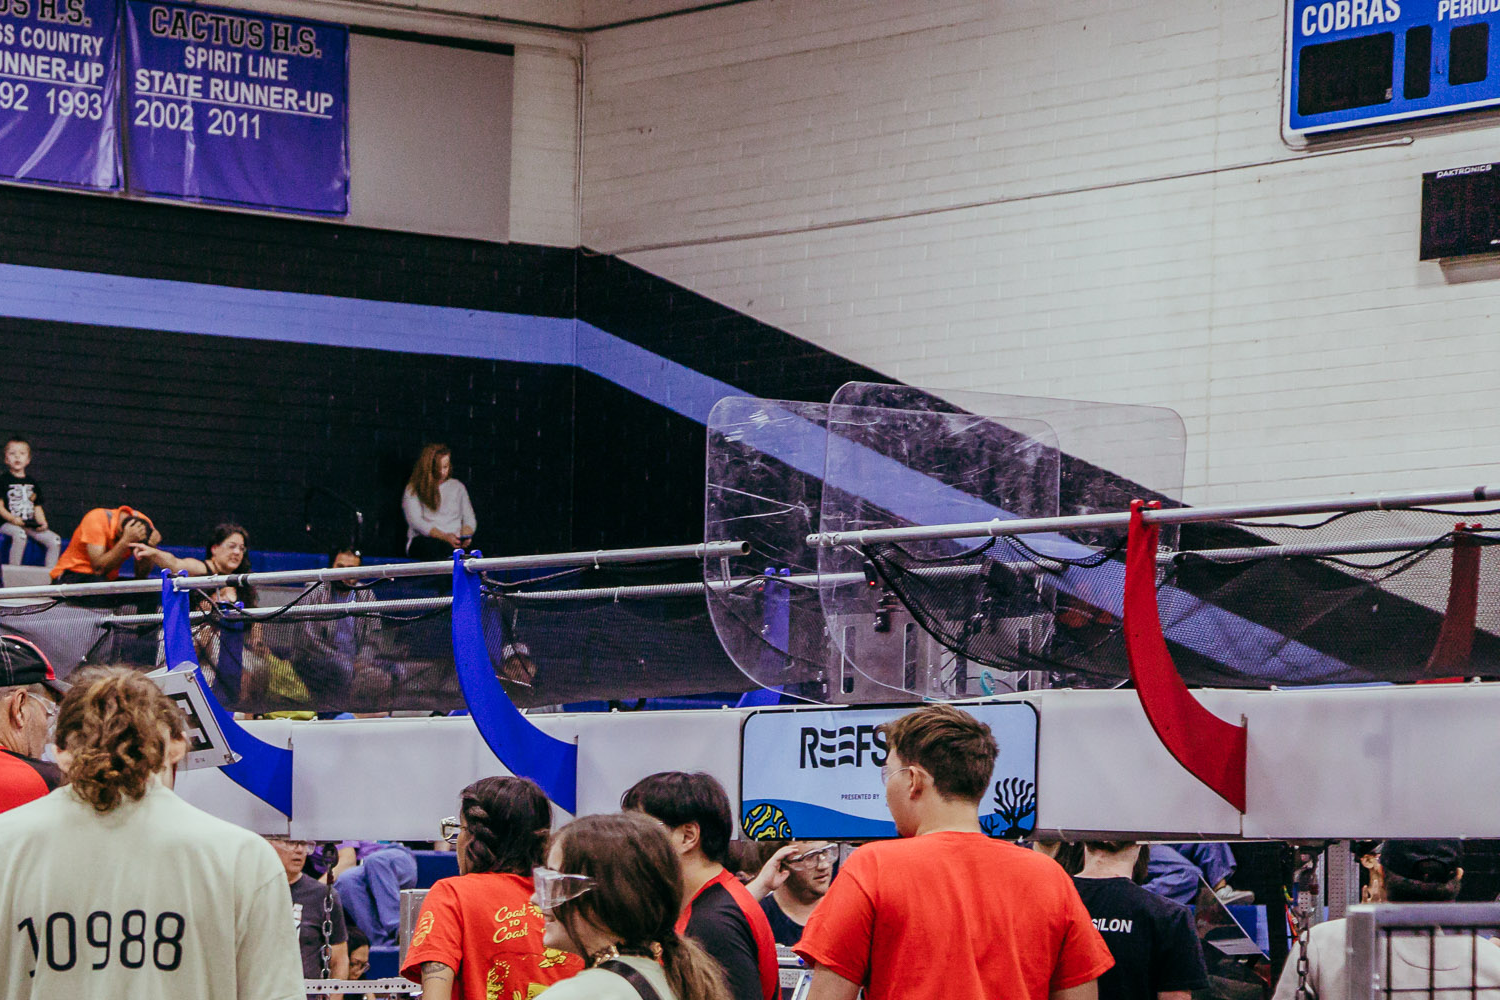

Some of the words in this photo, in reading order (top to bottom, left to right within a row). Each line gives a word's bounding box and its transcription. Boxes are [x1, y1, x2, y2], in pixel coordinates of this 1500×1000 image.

[151, 6, 265, 50] CACTUS
[271, 22, 322, 58] H.S.
[1301, 0, 1400, 36] COBRAS
[20, 26, 104, 57] COUNTRY
[184, 46, 243, 75] SPIRIT
[249, 55, 288, 81] LINE
[46, 87, 103, 120] 1993
[135, 68, 204, 98] STATE
[210, 77, 334, 115] RUNNER-UP
[134, 99, 194, 132] 2002
[208, 108, 260, 139] 2011
[799, 724, 891, 769] REEFS
[495, 904, 527, 923] Coast
[17, 909, 186, 979] 10988
[493, 922, 528, 943] Coast
